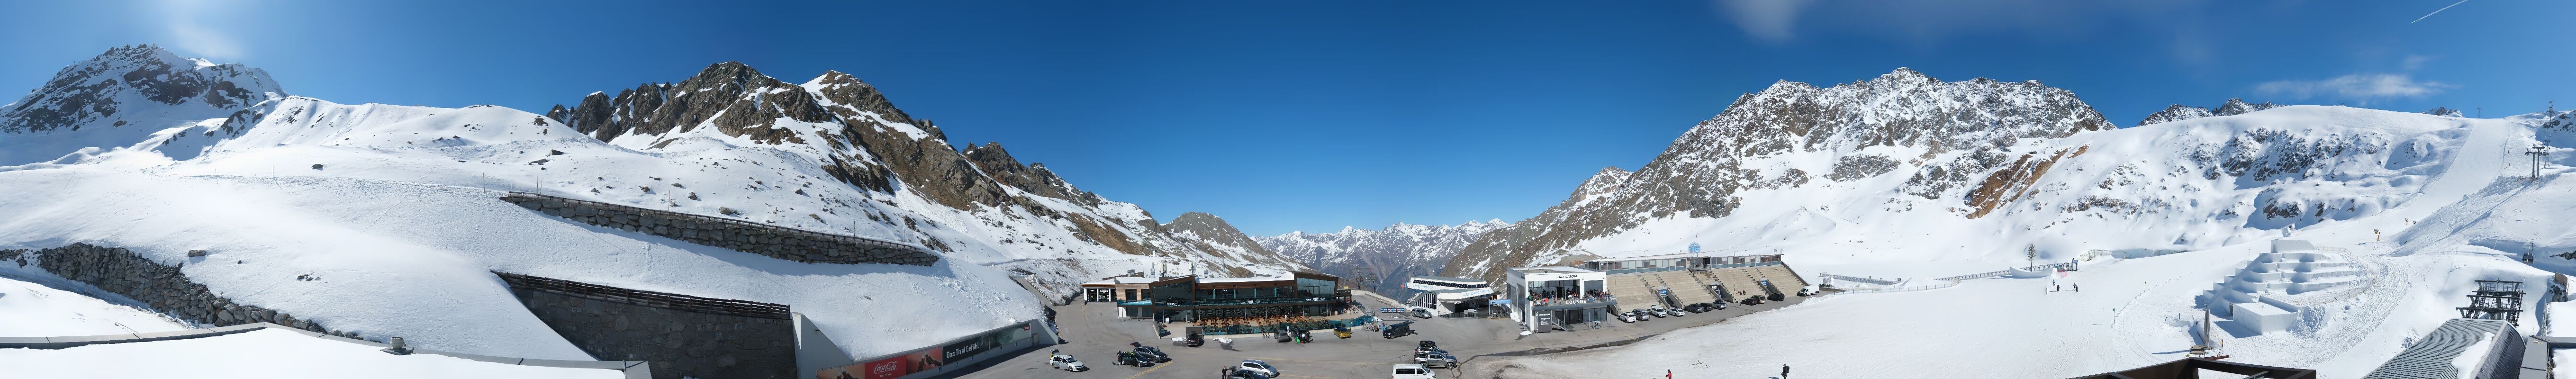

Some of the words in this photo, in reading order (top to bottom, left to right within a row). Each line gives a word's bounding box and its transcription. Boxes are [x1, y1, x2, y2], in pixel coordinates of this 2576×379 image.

[956, 346, 966, 356] Tirol
[966, 342, 979, 352] Gefühl
[874, 361, 898, 374] Coca-Cola
